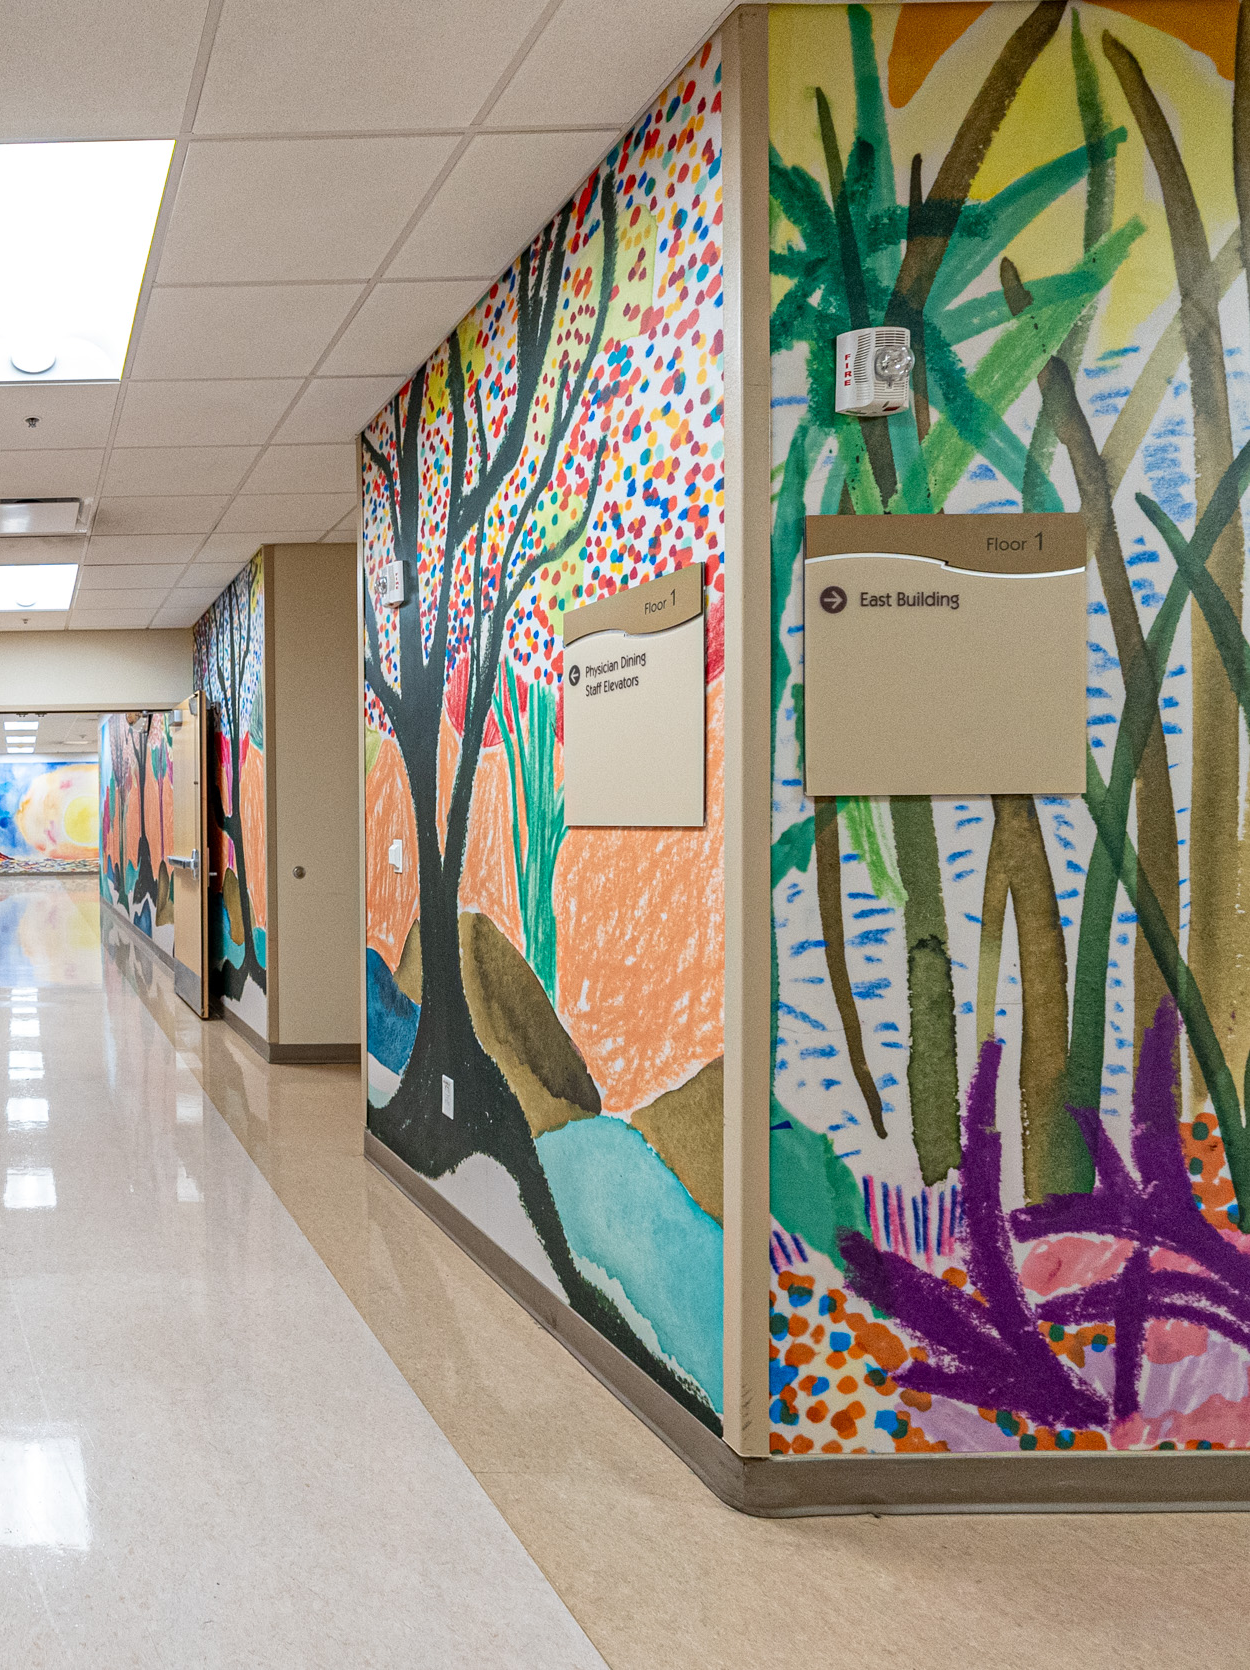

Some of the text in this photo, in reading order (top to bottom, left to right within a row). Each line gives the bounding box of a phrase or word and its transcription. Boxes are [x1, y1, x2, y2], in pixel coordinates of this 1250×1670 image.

[844, 354, 852, 386] FIRE
[986, 531, 1043, 551] Floor 1
[645, 589, 676, 615] Floor 1
[860, 592, 960, 610] East Building
[585, 653, 646, 678] Physician Dining
[585, 676, 639, 697] Staff Elevators
